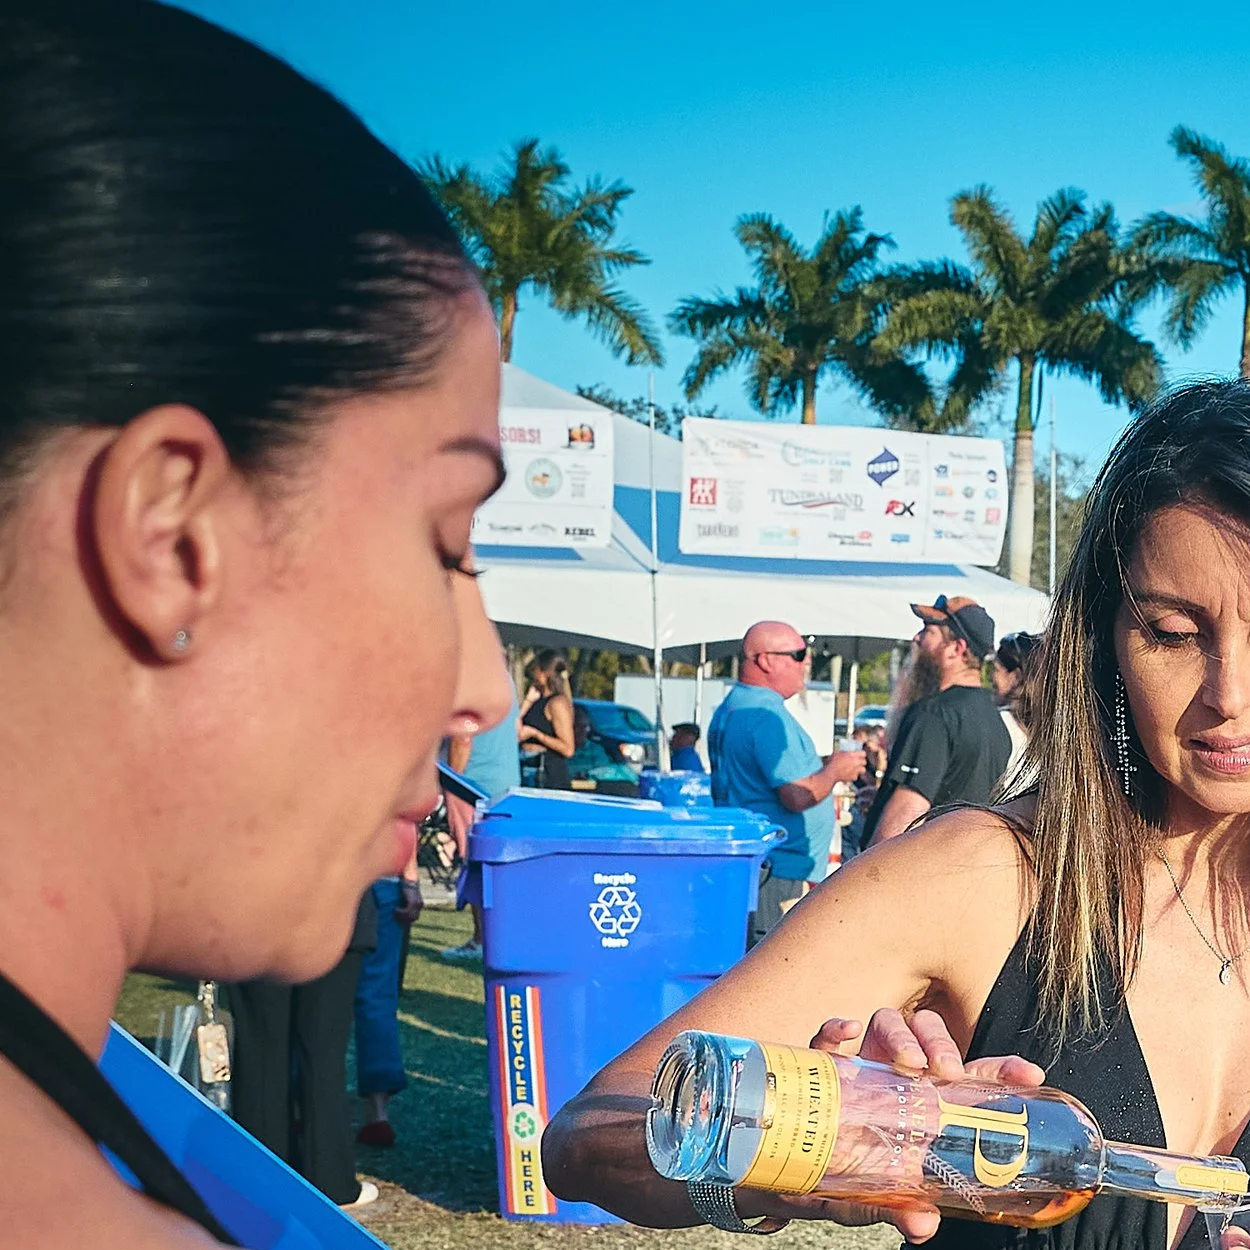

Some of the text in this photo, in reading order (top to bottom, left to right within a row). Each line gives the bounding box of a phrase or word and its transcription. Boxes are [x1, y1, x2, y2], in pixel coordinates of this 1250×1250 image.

[594, 872, 637, 886] Recycle
[509, 994, 528, 1101] RECYCLE
[801, 1067, 820, 1153] WHEATED
[890, 1085, 907, 1167] BOURBON
[521, 1150, 536, 1207] HERE
